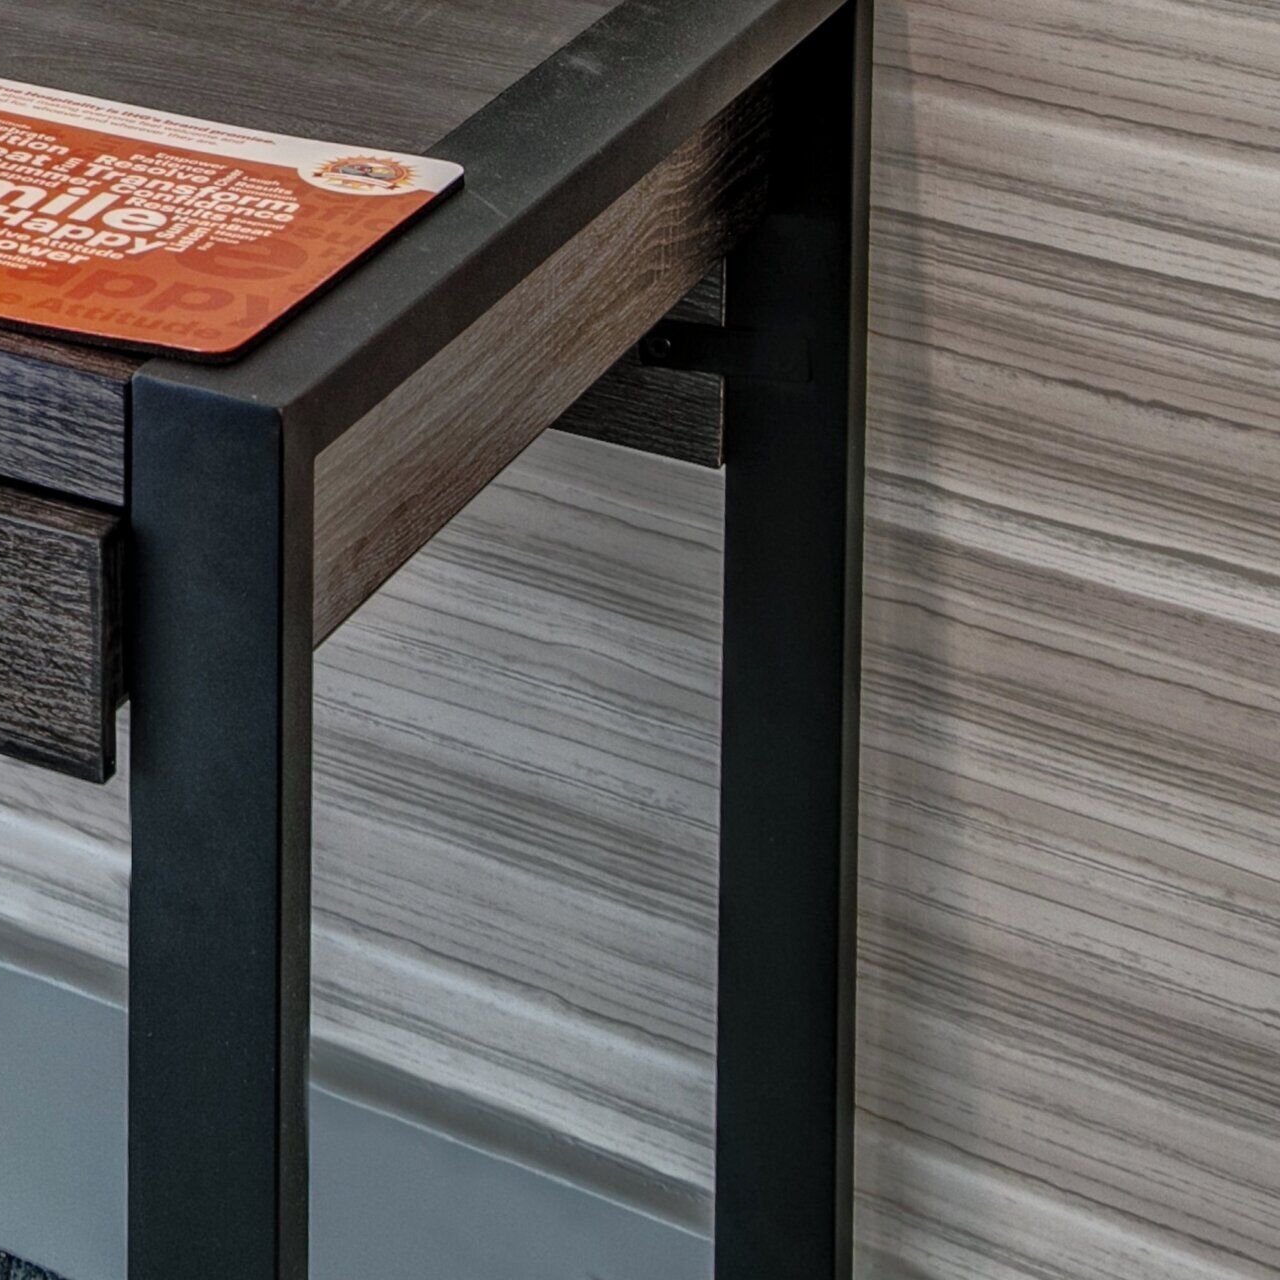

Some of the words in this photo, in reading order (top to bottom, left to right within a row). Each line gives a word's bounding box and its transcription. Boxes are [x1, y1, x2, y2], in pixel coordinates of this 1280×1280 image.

[93, 154, 210, 183] Resolve
[130, 154, 217, 175] Patience
[155, 152, 228, 171] Empower
[84, 163, 300, 213] Transform
[110, 183, 294, 222] Confidence
[124, 197, 227, 222] Results
[171, 215, 273, 237] HeartBeat
[33, 237, 124, 260] Attitude
